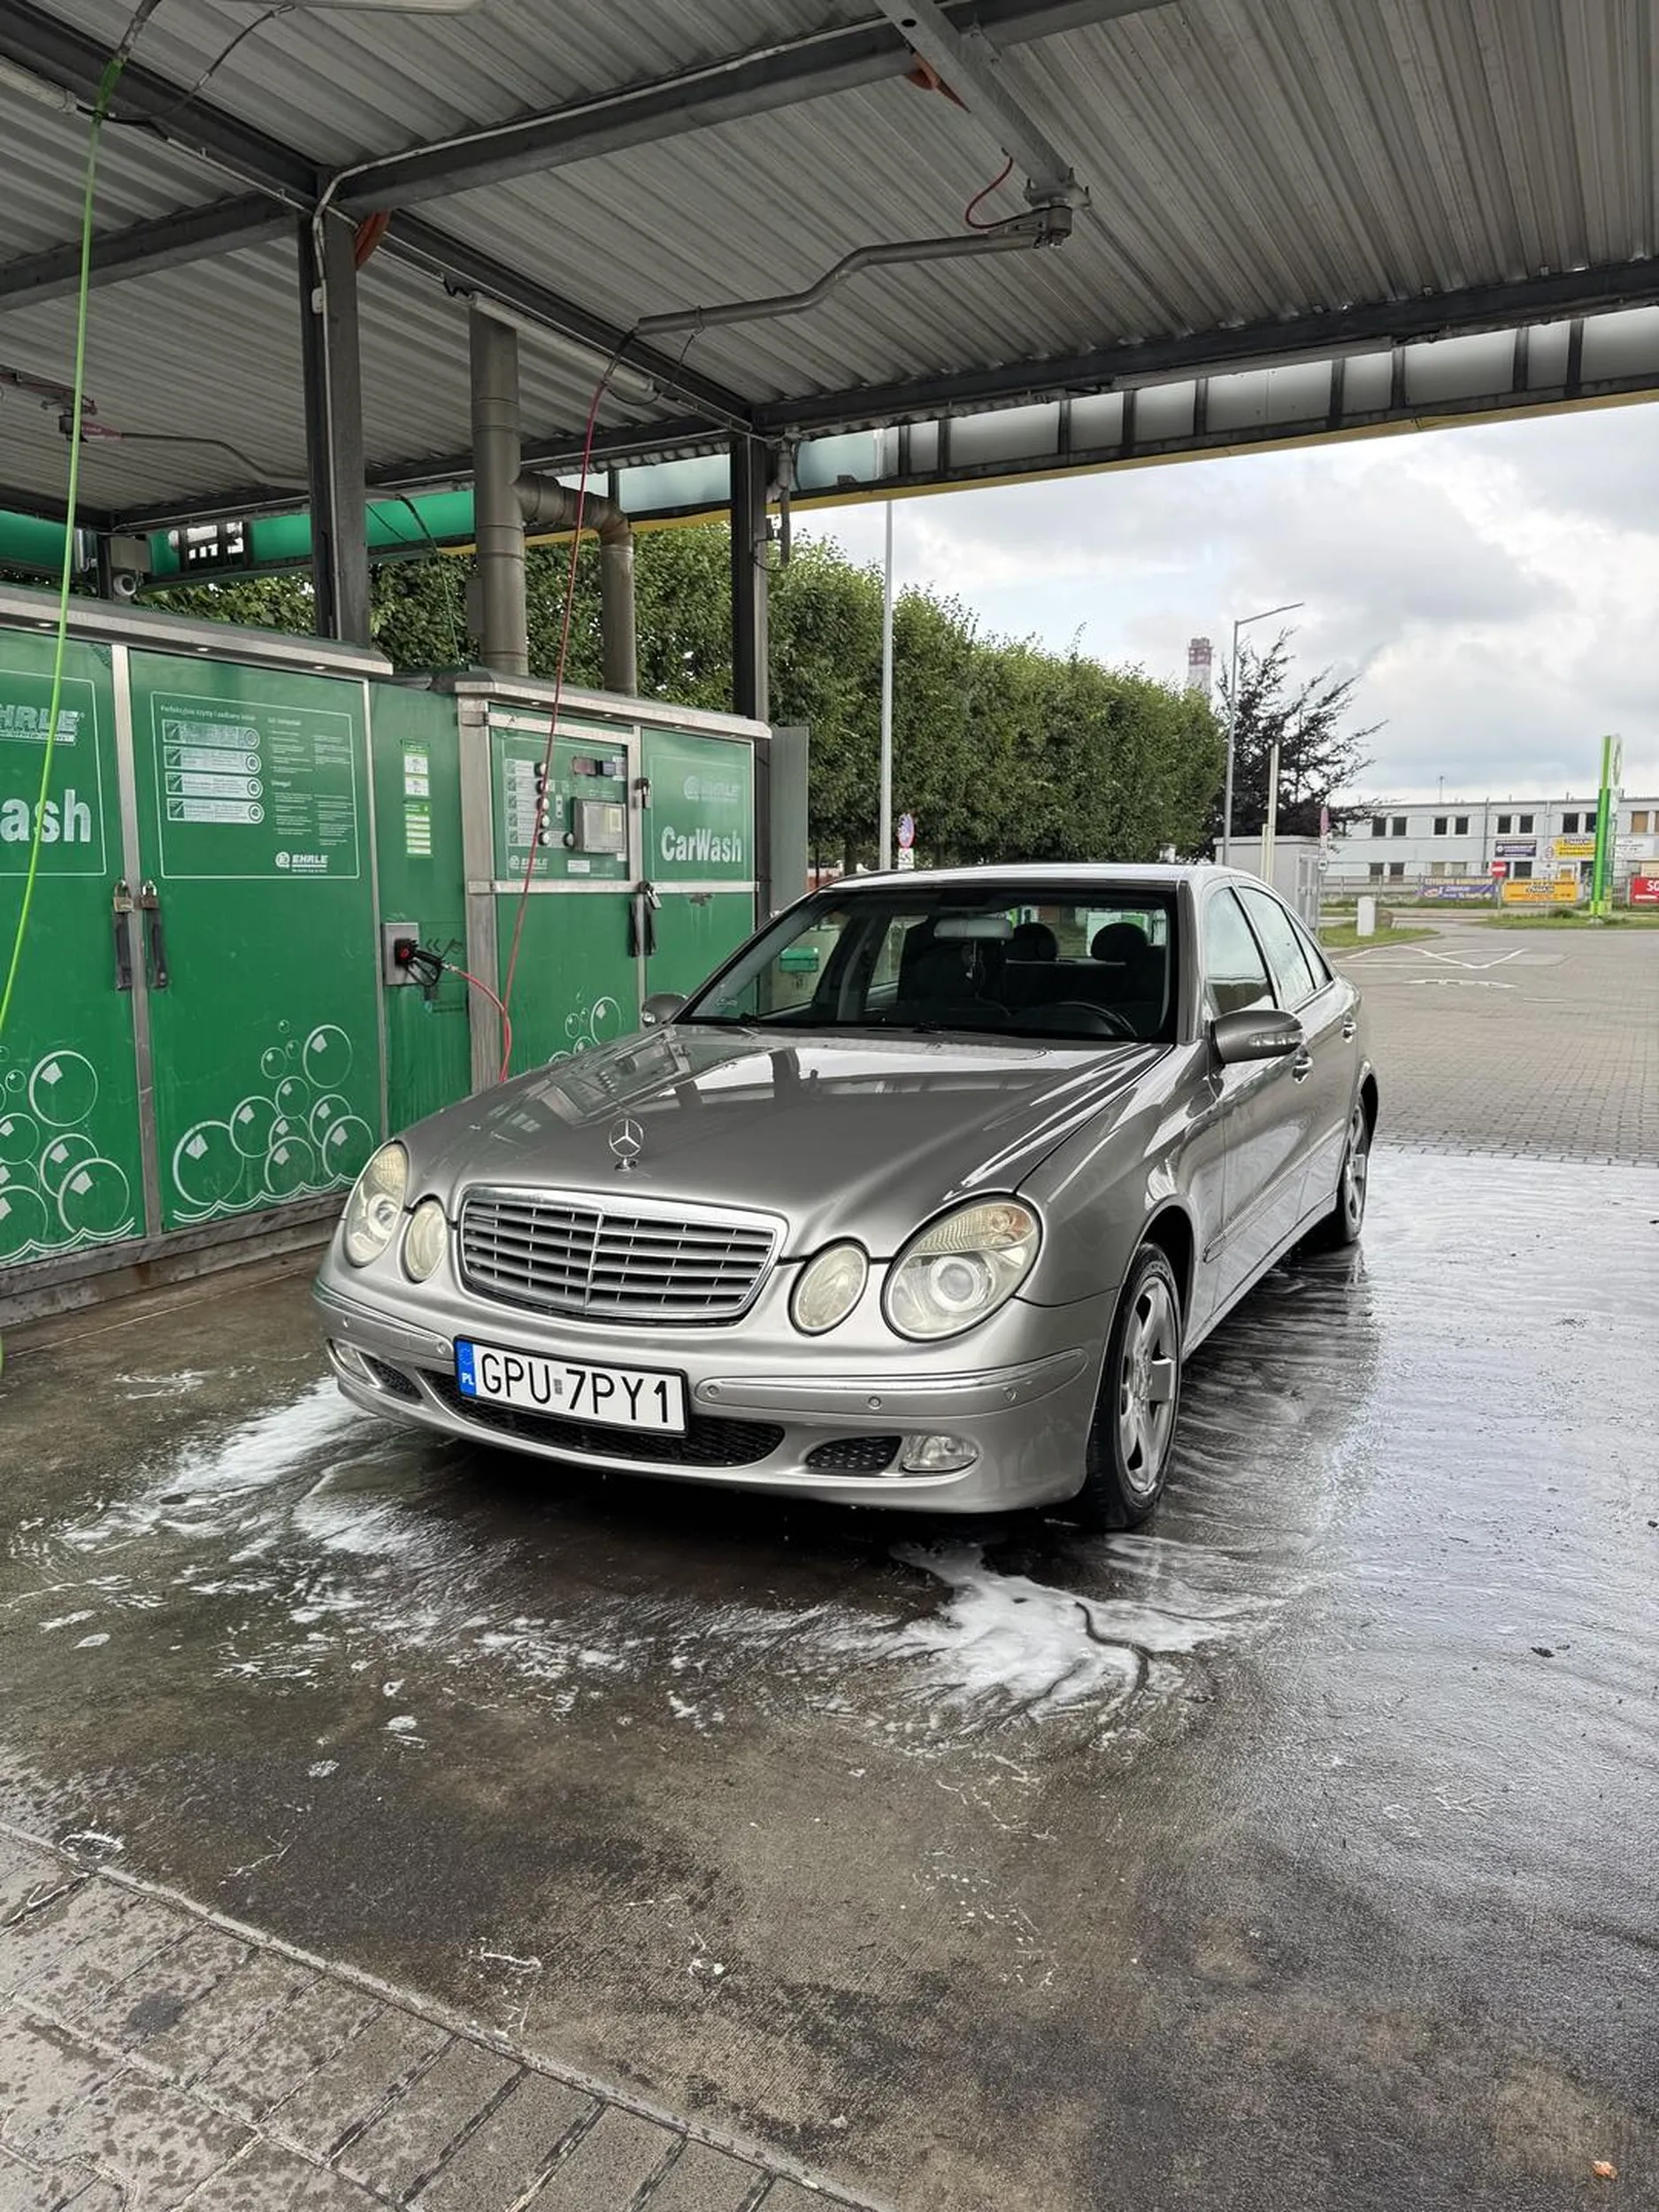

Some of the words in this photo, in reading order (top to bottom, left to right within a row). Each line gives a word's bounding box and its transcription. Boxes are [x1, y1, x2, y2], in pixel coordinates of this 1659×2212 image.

[0, 703, 79, 732] HRLE
[0, 789, 91, 842] ash
[661, 826, 741, 862] CarWash
[462, 1372, 474, 1385] PL
[481, 1353, 551, 1404] GPU
[566, 1368, 668, 1423] 7PY1
